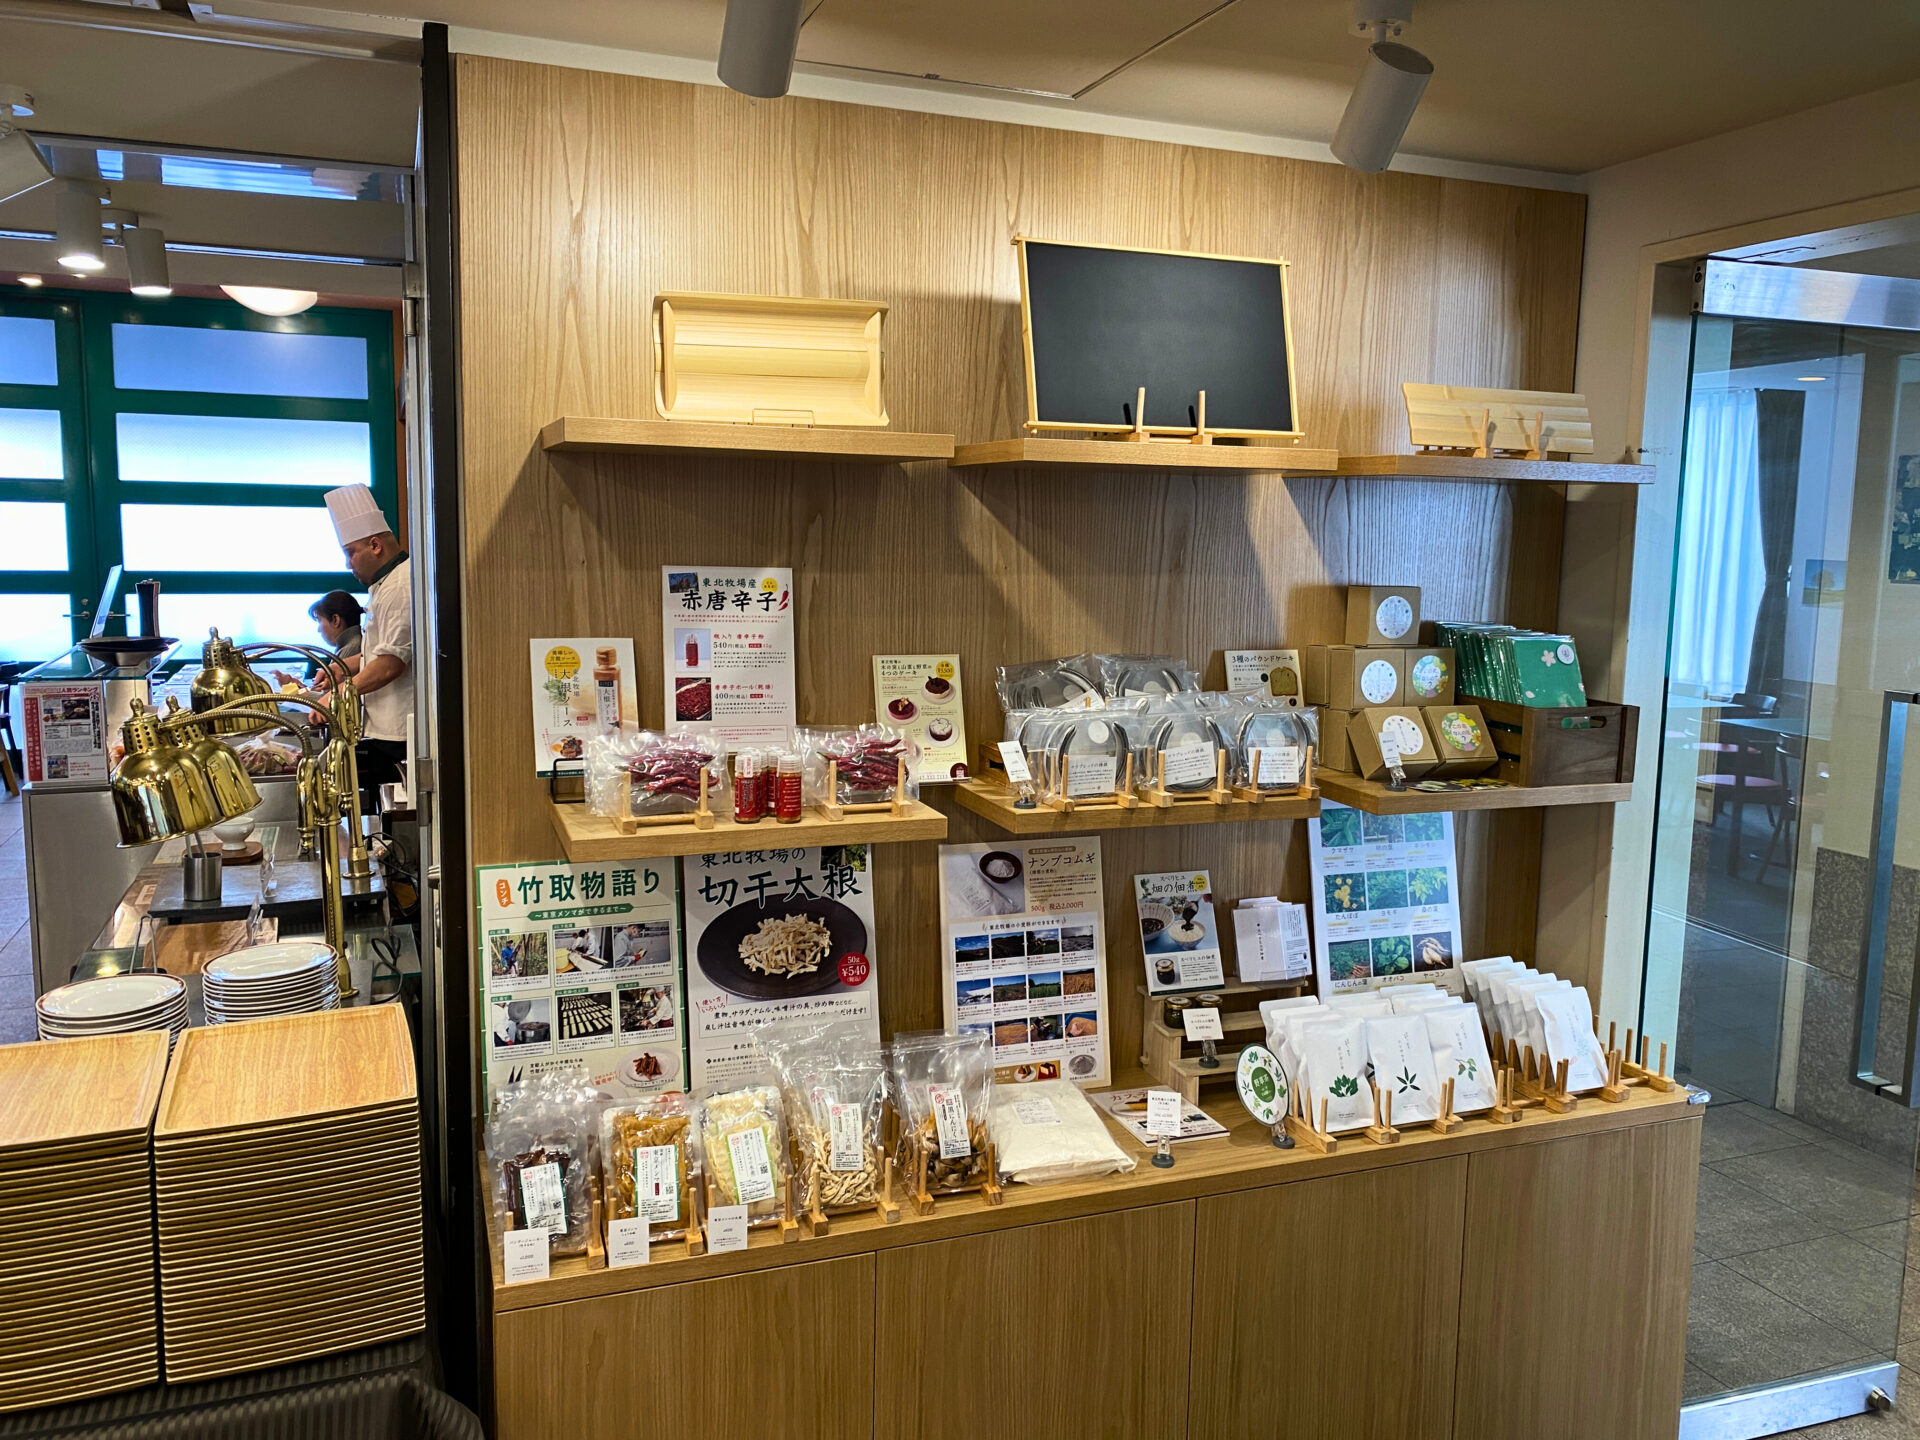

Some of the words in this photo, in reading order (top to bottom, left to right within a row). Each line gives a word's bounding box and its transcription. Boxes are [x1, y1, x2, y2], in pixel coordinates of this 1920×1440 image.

[702, 578, 757, 589] 東北牧場産
[682, 590, 777, 612] 赤唐辛子
[700, 847, 806, 868] 東北牧場の
[1028, 853, 1095, 869] ナンブコムギ
[517, 868, 660, 905] 竹取物語り
[698, 865, 863, 909] 切干大根
[1152, 880, 1198, 893] 畑の佃煮
[841, 965, 867, 977] ¥540
